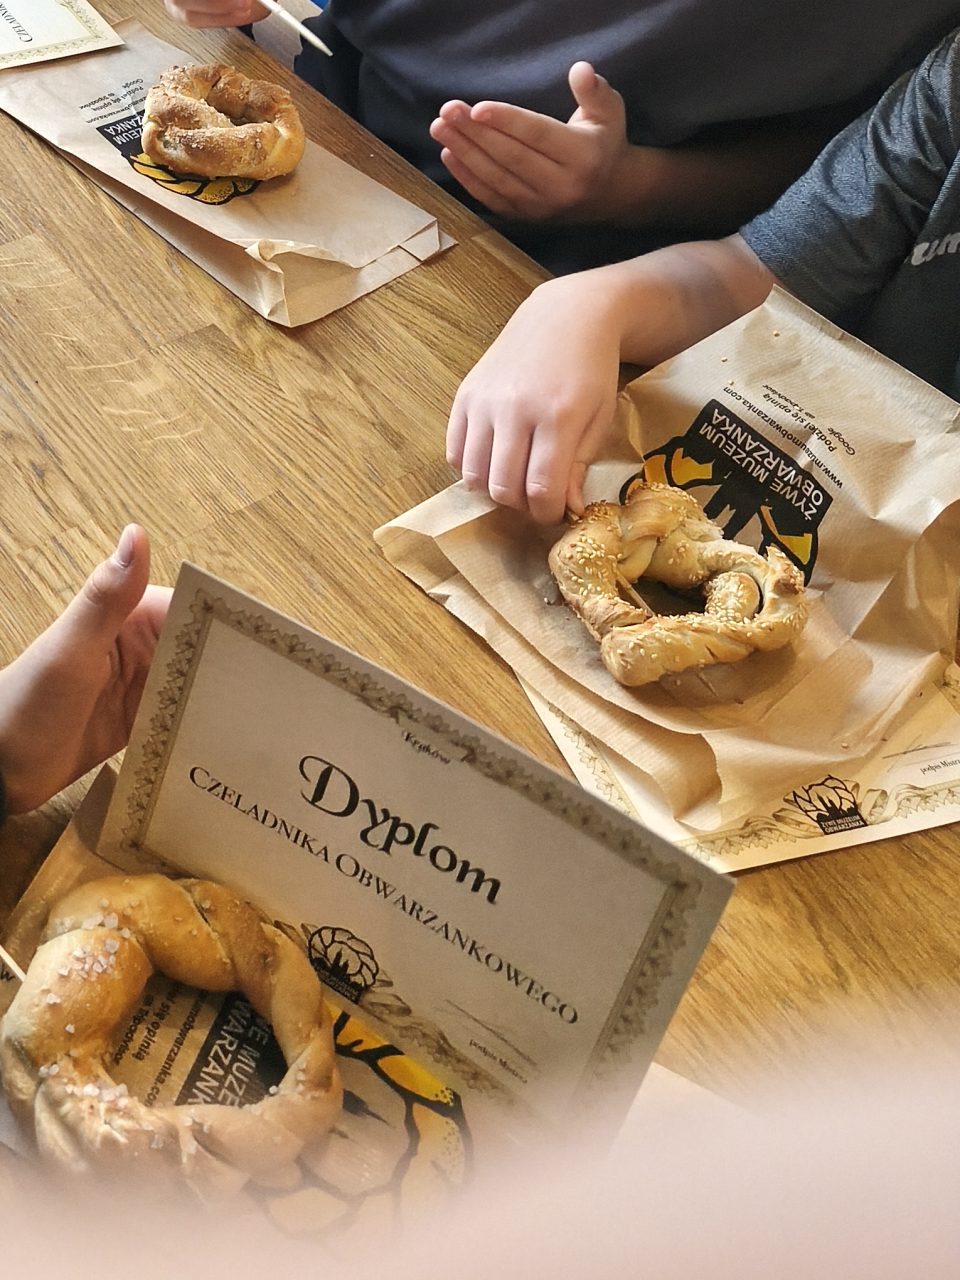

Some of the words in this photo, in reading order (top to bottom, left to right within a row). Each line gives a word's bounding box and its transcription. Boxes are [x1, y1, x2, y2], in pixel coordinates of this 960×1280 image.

[103, 115, 144, 136] ZANKA
[112, 127, 143, 145] ZEUM
[762, 393, 793, 413] opinią
[791, 412, 805, 424] się
[699, 422, 770, 484] MUZEUM
[711, 408, 824, 506] OBWARZANKA
[723, 386, 844, 489] www.muzeumobwarzanka.com
[803, 422, 838, 453] Podziel
[827, 427, 856, 456] Google
[769, 477, 817, 521] ŻYWE
[299, 755, 501, 905] Dyplom
[189, 765, 330, 864] CZELADNIKA
[336, 853, 580, 1025] OBWARZANKOWEGO
[218, 1043, 261, 1106] MUZE
